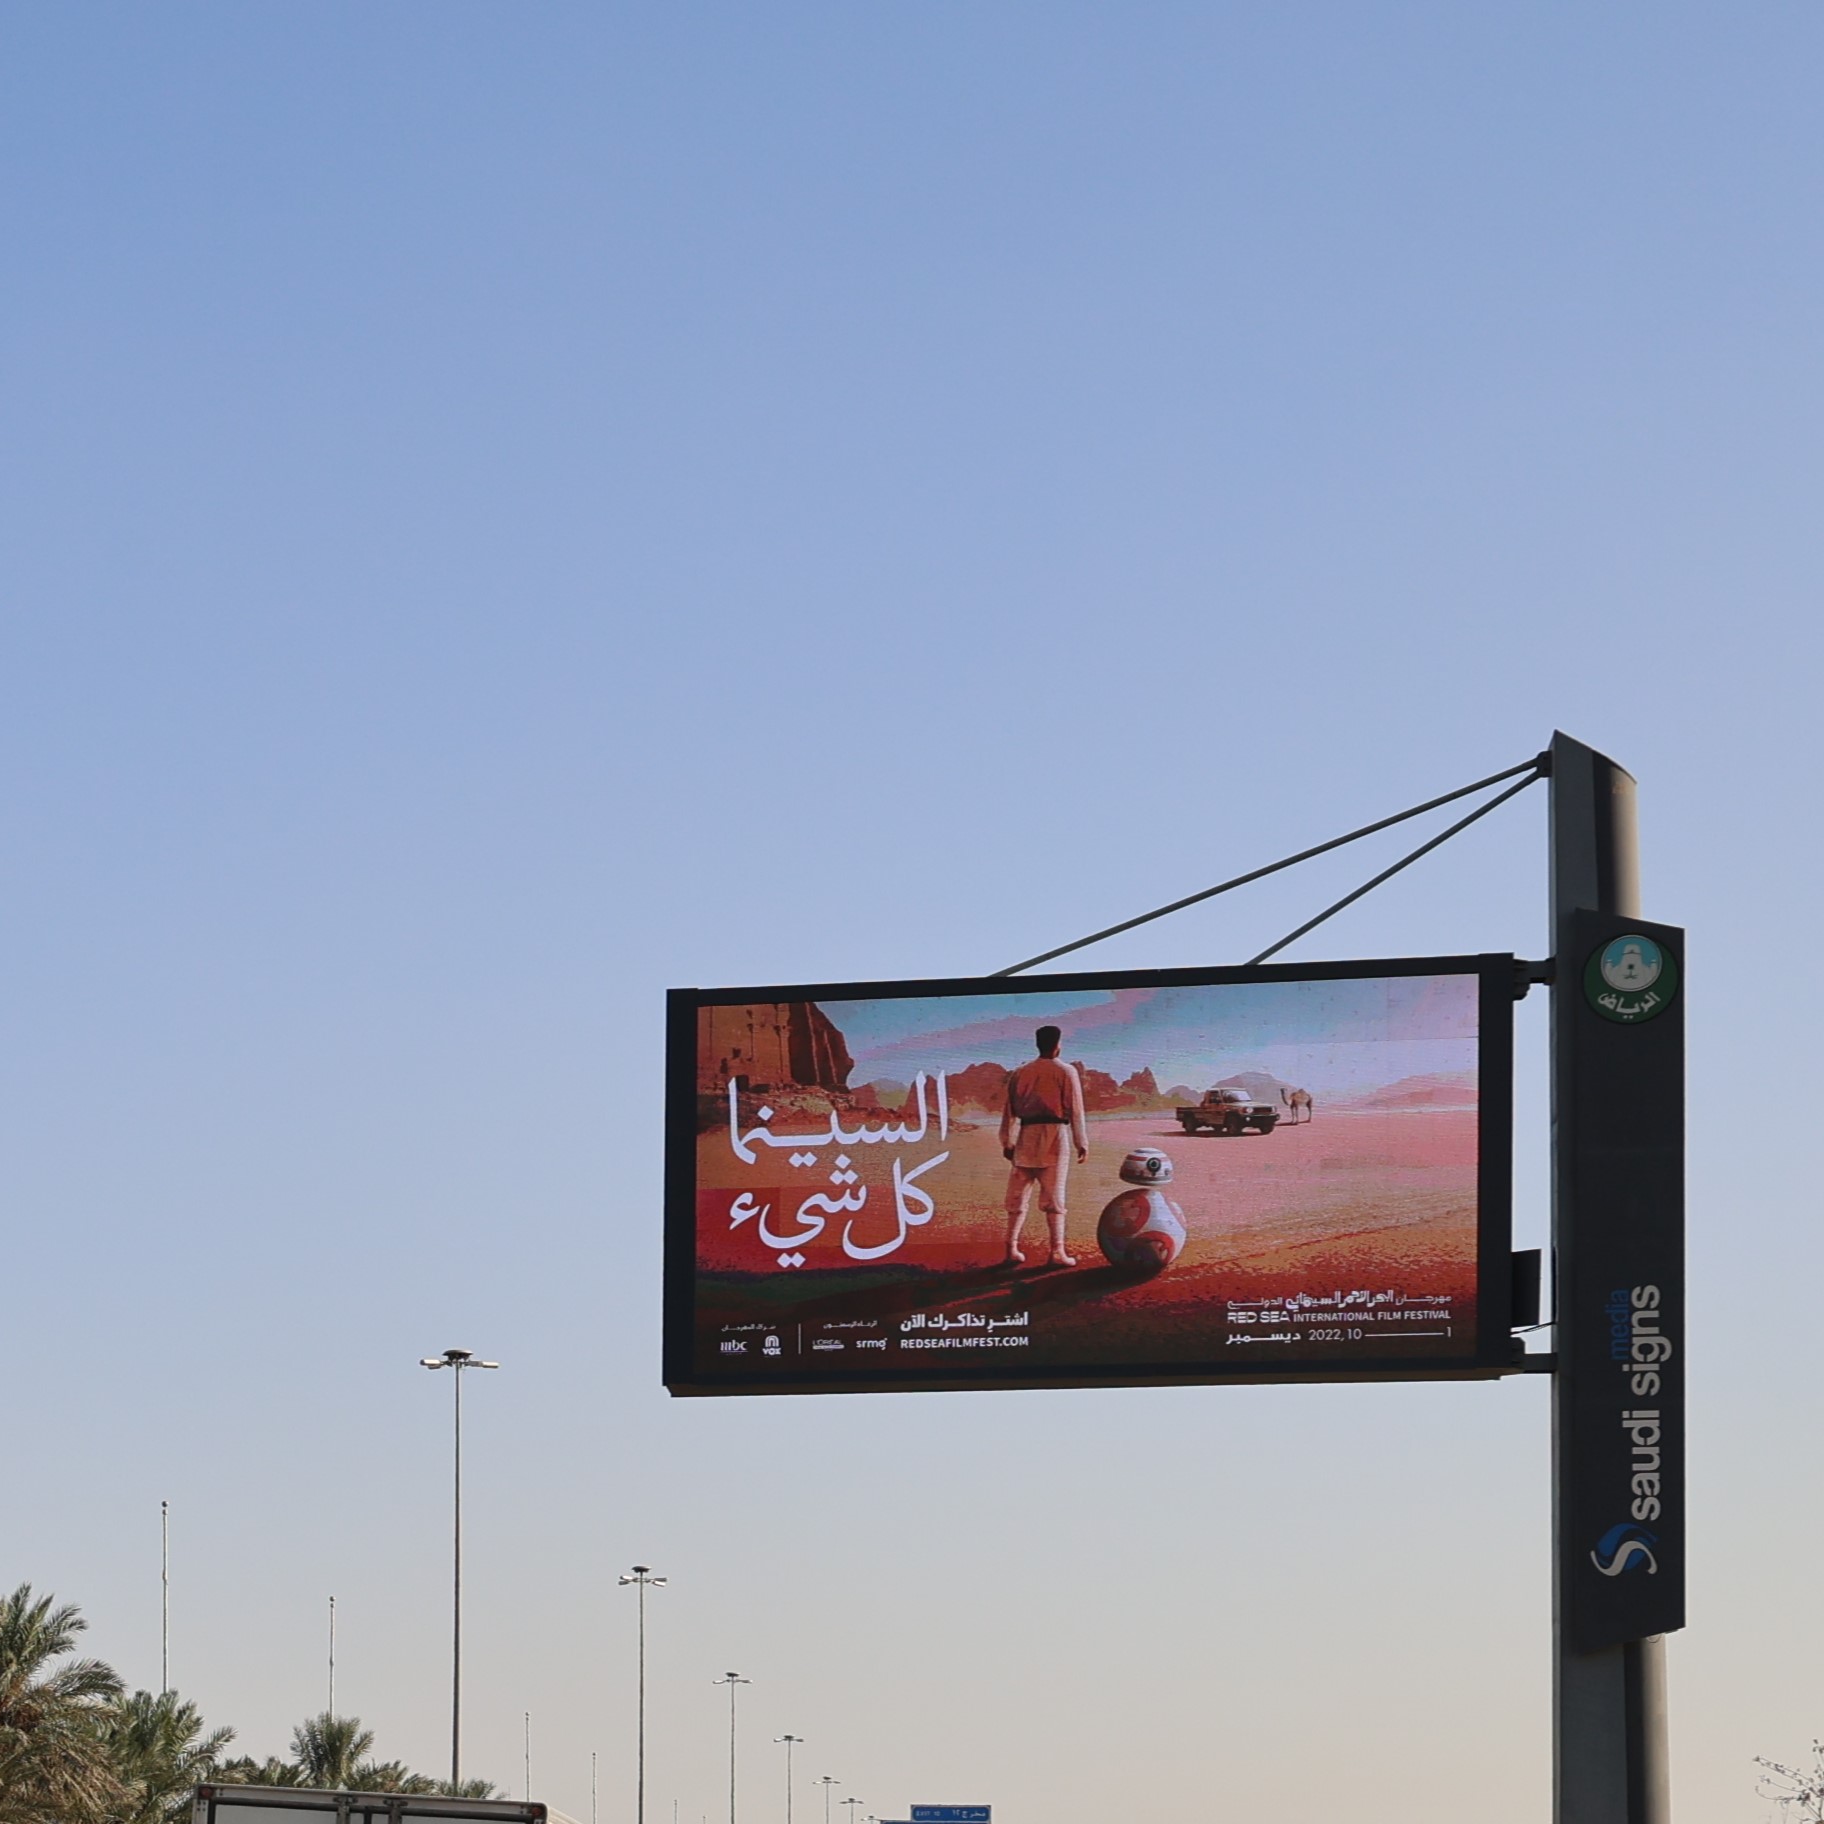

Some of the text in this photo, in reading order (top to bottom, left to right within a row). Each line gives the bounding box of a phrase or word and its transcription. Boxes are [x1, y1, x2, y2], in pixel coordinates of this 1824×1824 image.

[1598, 991, 1661, 1019] الرياض
[728, 1069, 948, 1167] السينما
[729, 1150, 949, 1268] كل شيء
[928, 1313, 986, 1331] تذاكرك
[1227, 1309, 1452, 1324] RED SEA INTERNATIONAL FILM FESTIVAL
[1604, 1288, 1631, 1361] media
[720, 1339, 748, 1351] mbc
[900, 1336, 1029, 1349] REDSEAFILMFEST.COM
[1225, 1333, 1302, 1345] ديسمبر
[762, 1347, 781, 1356] VOX
[1622, 1284, 1672, 1520] saudi signs
